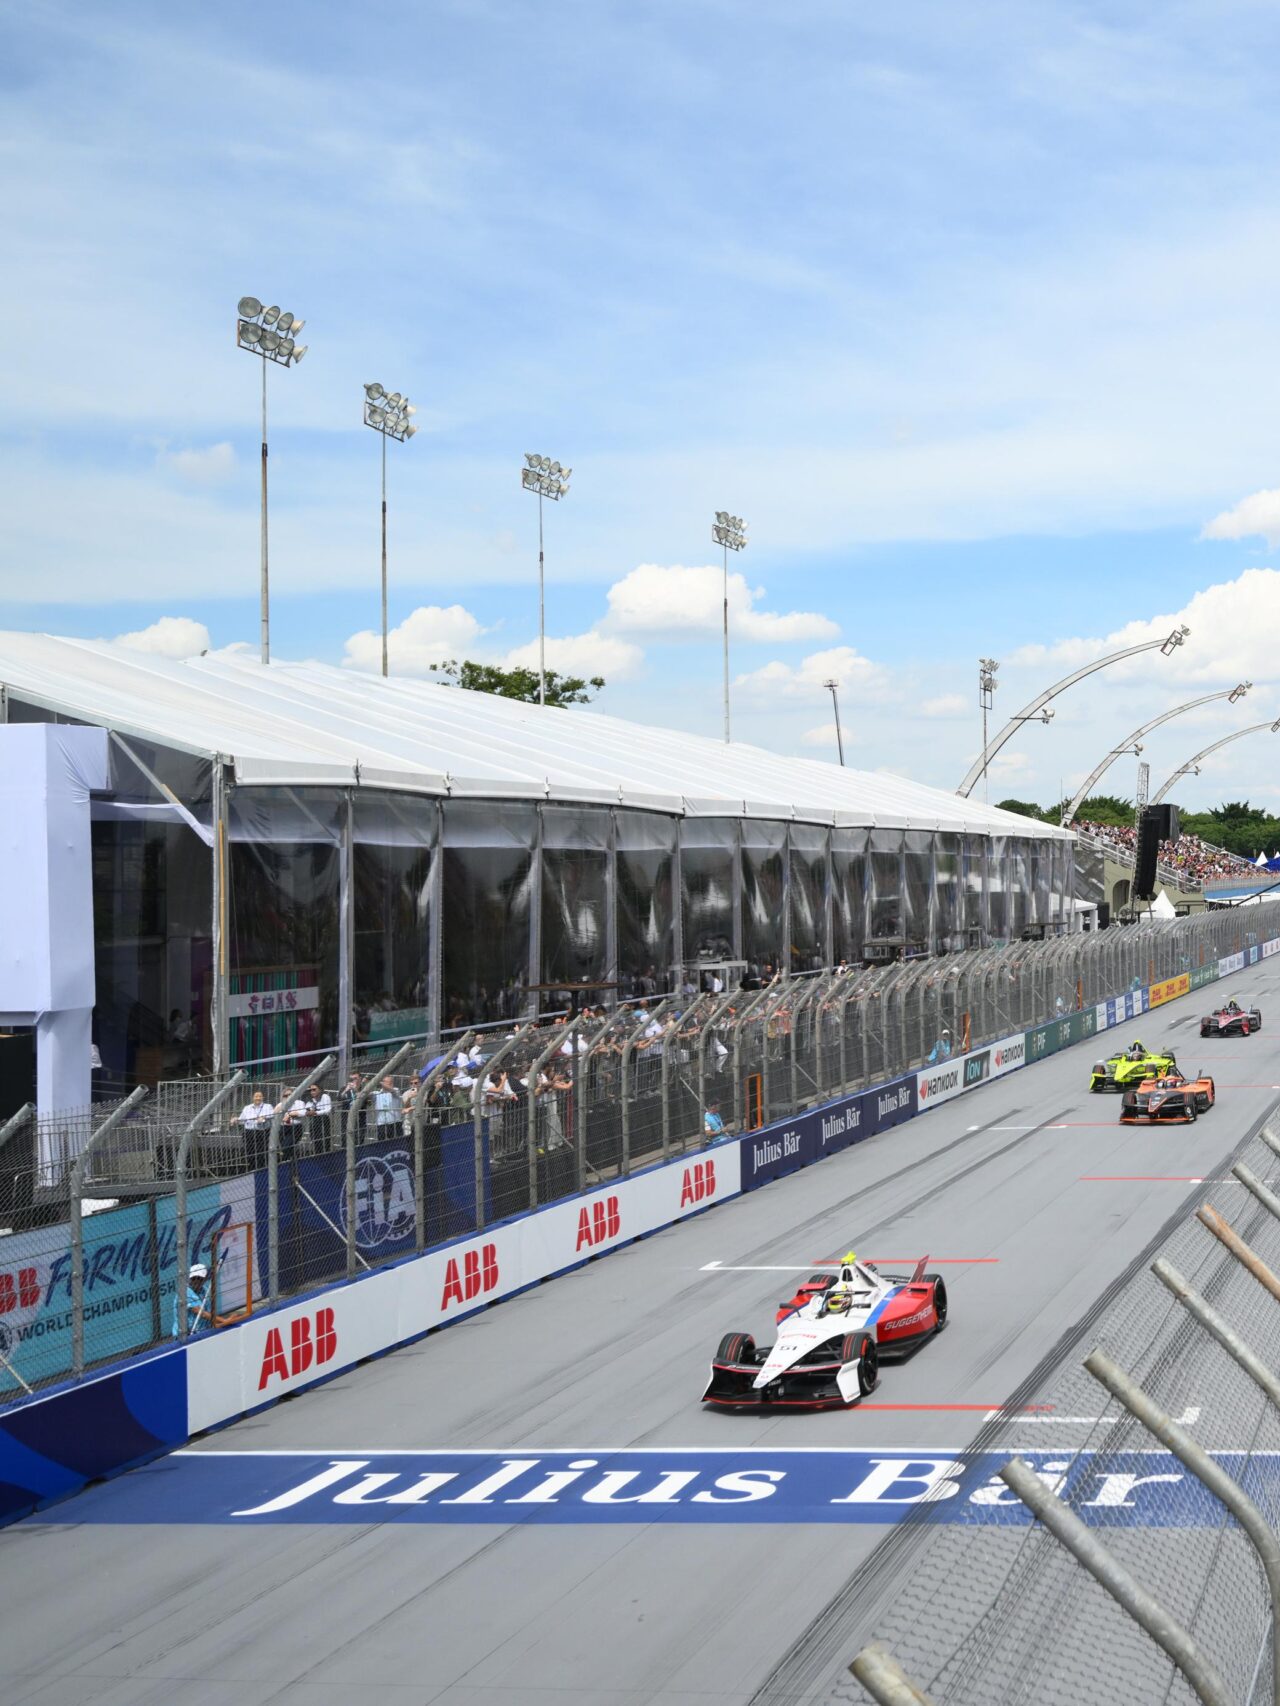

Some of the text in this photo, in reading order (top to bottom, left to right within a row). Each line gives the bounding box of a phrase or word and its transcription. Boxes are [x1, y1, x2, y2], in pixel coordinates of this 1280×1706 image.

[1037, 1032, 1046, 1051] PIF
[822, 1107, 861, 1146] Julius Bär
[878, 1086, 910, 1121] Julius Bär
[753, 1131, 801, 1175] Julius Bär
[681, 1160, 715, 1208] ABB
[576, 1196, 620, 1252] ABB
[0, 1267, 40, 1316] BB
[441, 1243, 499, 1311] ABB
[258, 1307, 337, 1390] ABB
[230, 1459, 1184, 1516] Julius Bär
